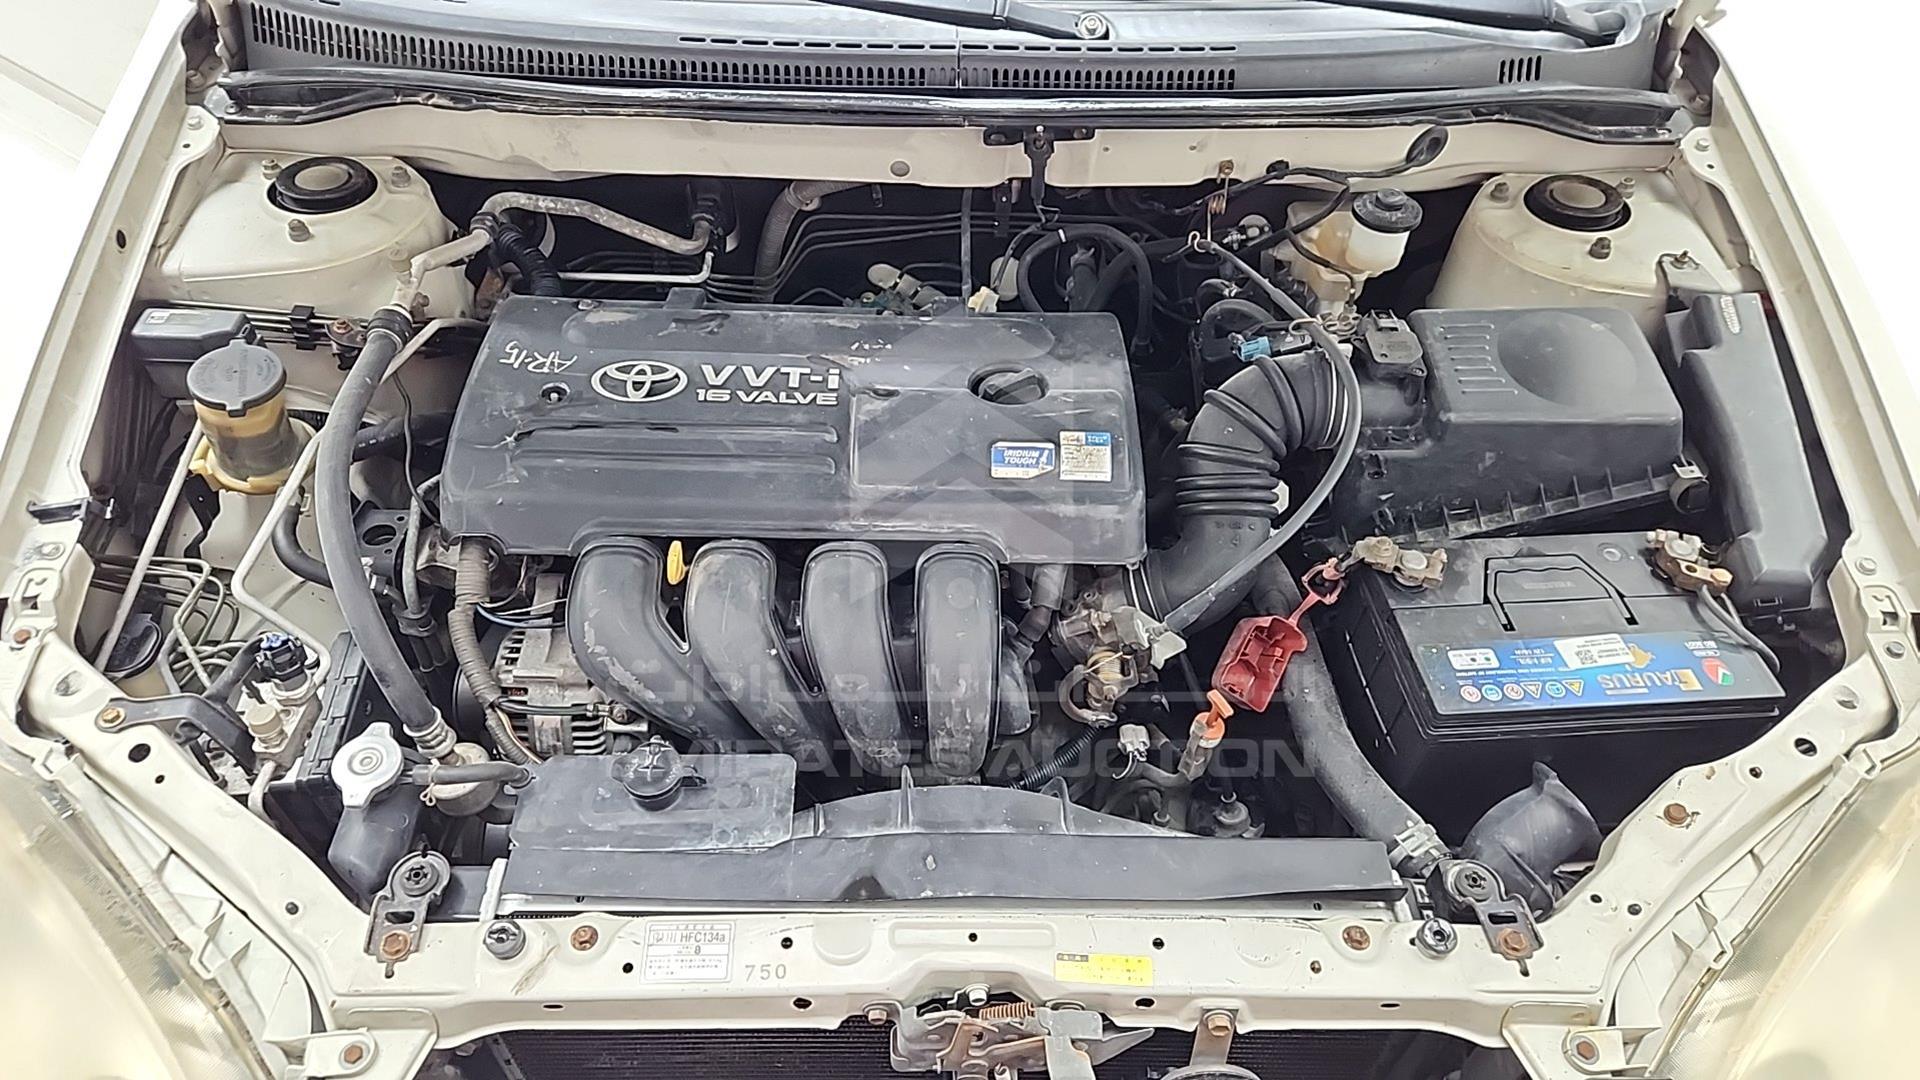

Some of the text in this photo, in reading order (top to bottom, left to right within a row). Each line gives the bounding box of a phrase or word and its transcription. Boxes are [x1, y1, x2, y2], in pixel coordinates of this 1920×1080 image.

[499, 340, 578, 374] AR-15
[701, 364, 842, 390] VVT-i
[696, 388, 839, 405] 16 VALVE
[1003, 449, 1039, 459] IRIDIUM
[1004, 458, 1037, 466] TOUGH
[1597, 668, 1704, 693] TAURUS
[680, 931, 726, 944] HFC134a
[745, 963, 787, 982] 750
